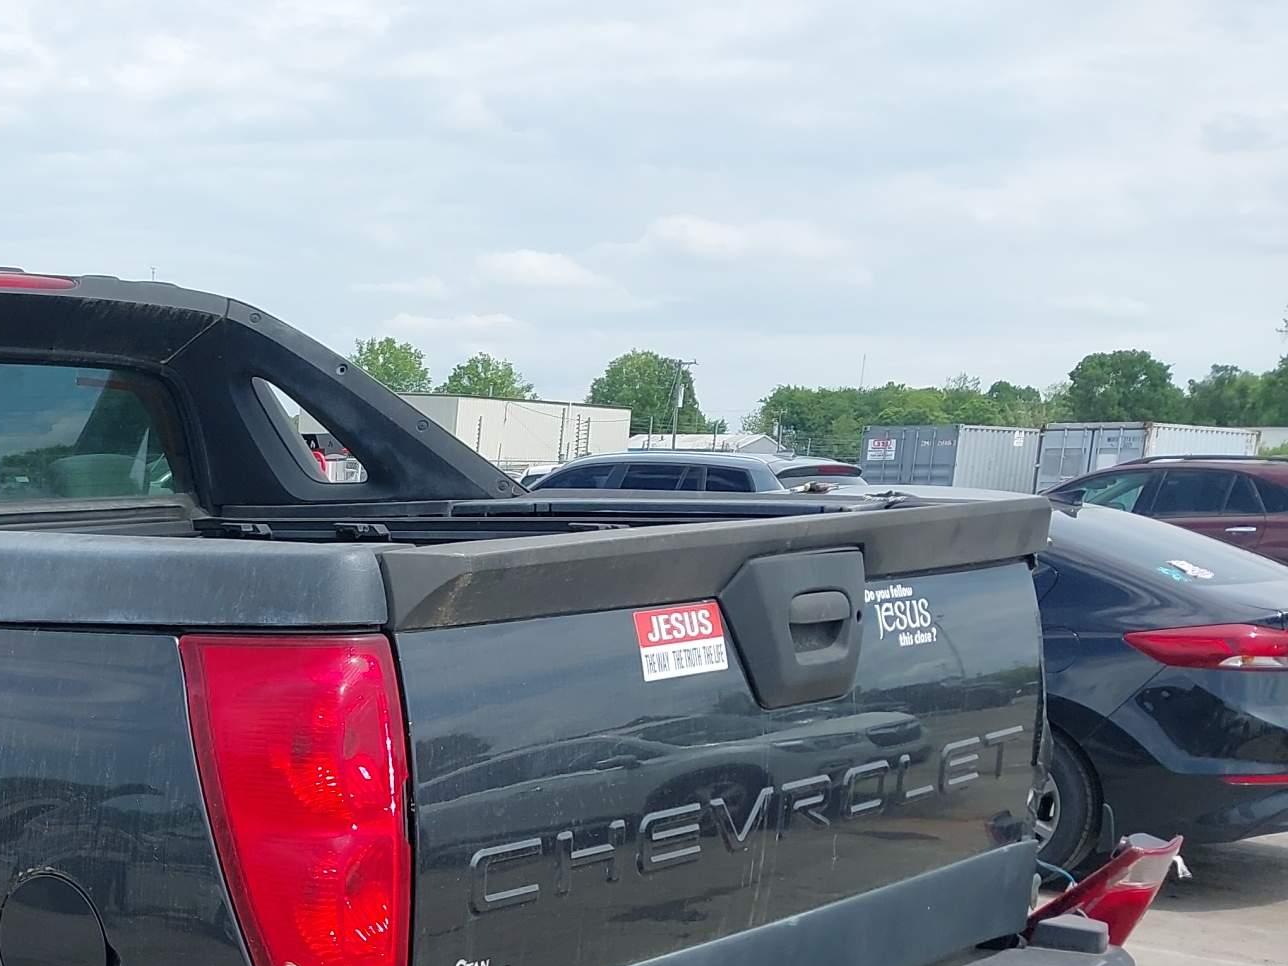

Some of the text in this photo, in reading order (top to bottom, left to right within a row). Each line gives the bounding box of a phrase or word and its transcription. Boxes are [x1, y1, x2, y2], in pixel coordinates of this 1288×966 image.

[864, 584, 913, 603] Do you follow
[647, 609, 713, 642] JESUS
[898, 631, 913, 647] this
[644, 643, 725, 675] THE WAY THE TRUTH THE LIFE
[468, 725, 1024, 916] CHEVROLET
